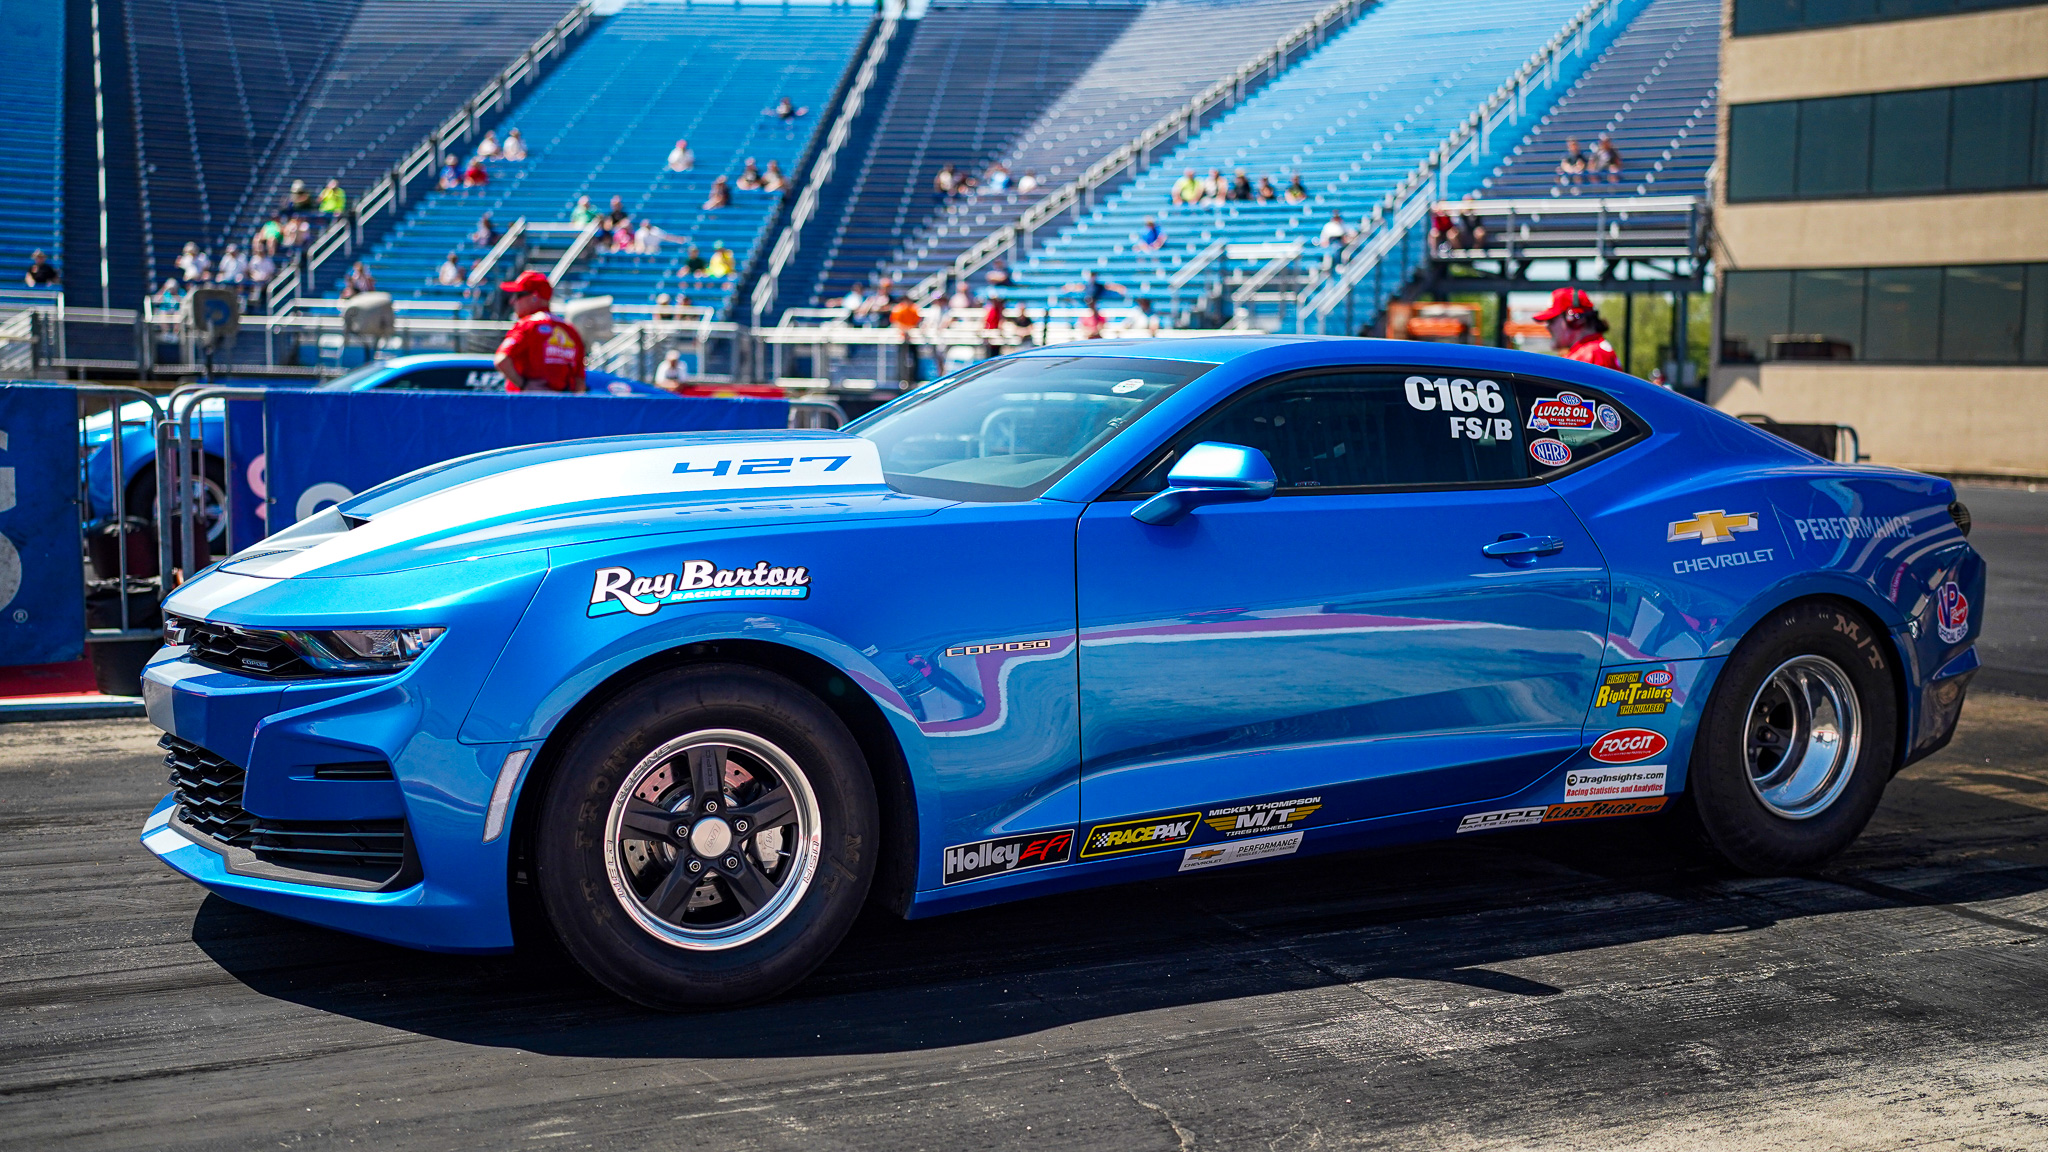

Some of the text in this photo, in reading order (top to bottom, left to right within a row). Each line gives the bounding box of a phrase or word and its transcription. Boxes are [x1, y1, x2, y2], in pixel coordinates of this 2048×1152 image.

[1404, 375, 1505, 413] C166
[1537, 405, 1572, 418] LUCAS
[1572, 408, 1589, 418] OIL
[1450, 416, 1513, 441] FS/B
[1536, 443, 1567, 461] NHRA
[672, 455, 852, 476] 427
[1795, 516, 1915, 541] PERFORMANCE
[1672, 548, 1774, 574] CHEVROLET
[590, 559, 810, 616] Ray Barton
[670, 588, 801, 601] RACING ENGINES
[1938, 582, 1960, 629] VP
[1832, 613, 1885, 670] M/T
[1607, 672, 1640, 684] RIGHT ON
[1648, 672, 1670, 684] NHRA
[1620, 703, 1665, 715] THE NUMBER
[1598, 735, 1655, 754] FOGGIT
[1579, 772, 1664, 784] DragInsights.com
[1566, 783, 1664, 797] Racing Statistics and Analytics
[1208, 796, 1322, 817] MICKEY THOMPSON
[1235, 808, 1296, 829] M/T
[1458, 817, 1542, 831] PARTS DIRECT
[1460, 809, 1546, 825] COPO
[1105, 820, 1192, 847] RACEPAK
[1225, 829, 1252, 837] TIRES
[1259, 823, 1294, 832] WHEELS
[946, 833, 1072, 875] Holley EFI
[1237, 837, 1299, 854] PERFORMANCE
[1183, 858, 1223, 868] CHEVROLET
